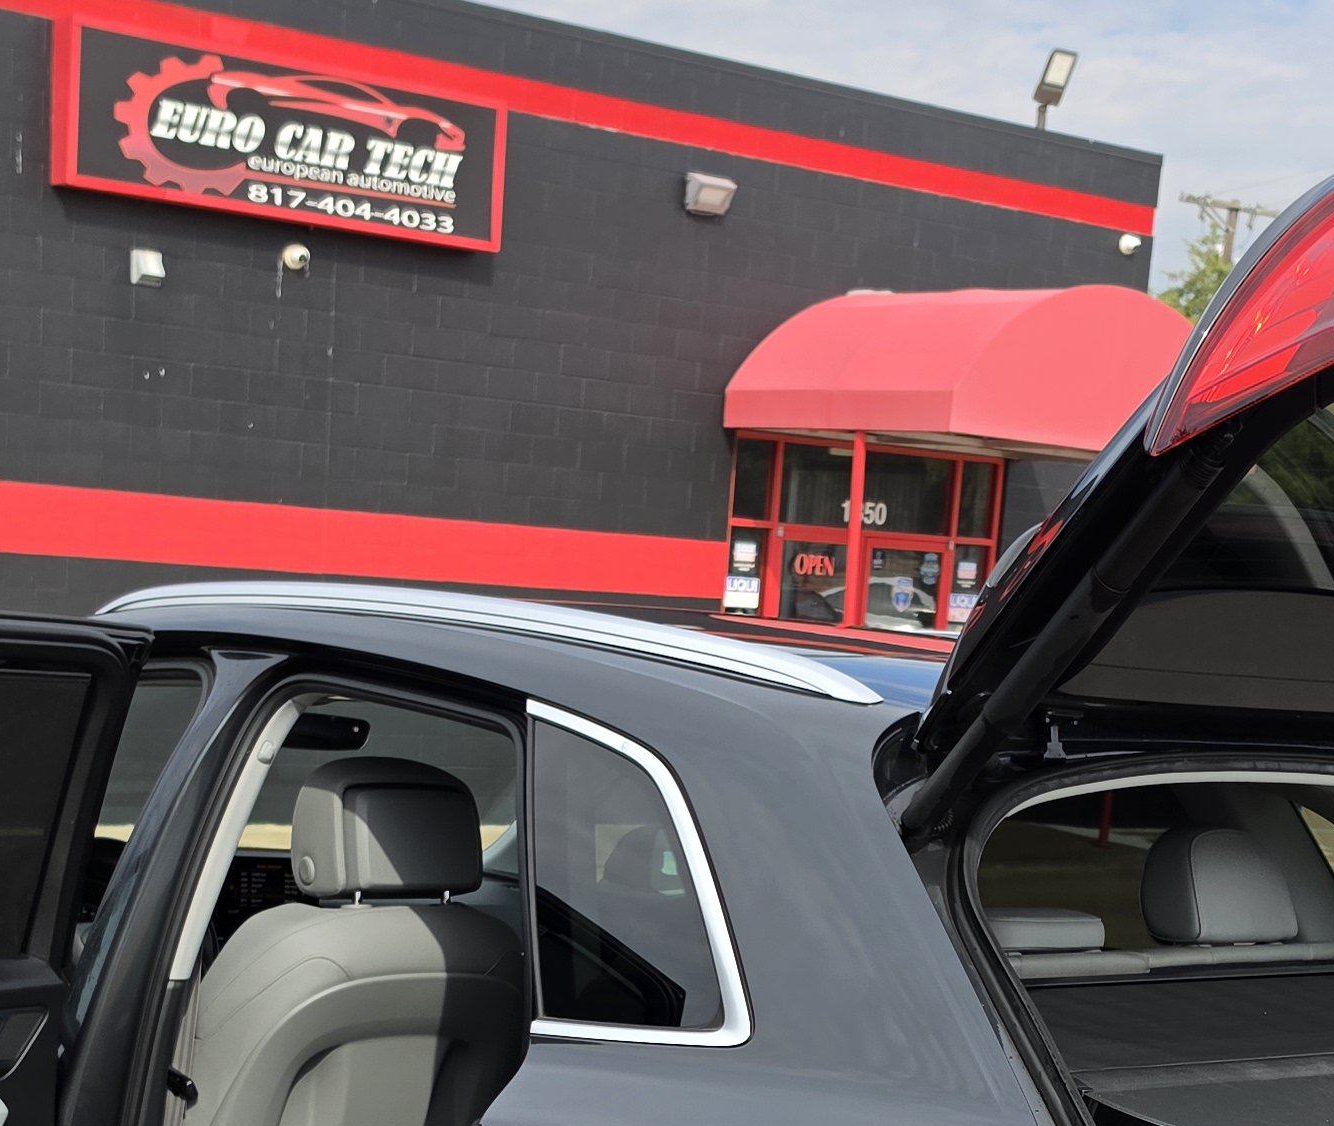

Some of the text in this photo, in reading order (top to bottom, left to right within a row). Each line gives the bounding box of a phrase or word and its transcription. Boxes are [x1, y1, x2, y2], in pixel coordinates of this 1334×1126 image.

[149, 98, 464, 189] EURO CAR TECH
[247, 155, 457, 204] european automotive
[247, 182, 455, 234] 817-404-4033
[841, 499, 887, 526] 150
[794, 553, 836, 577] OPEN
